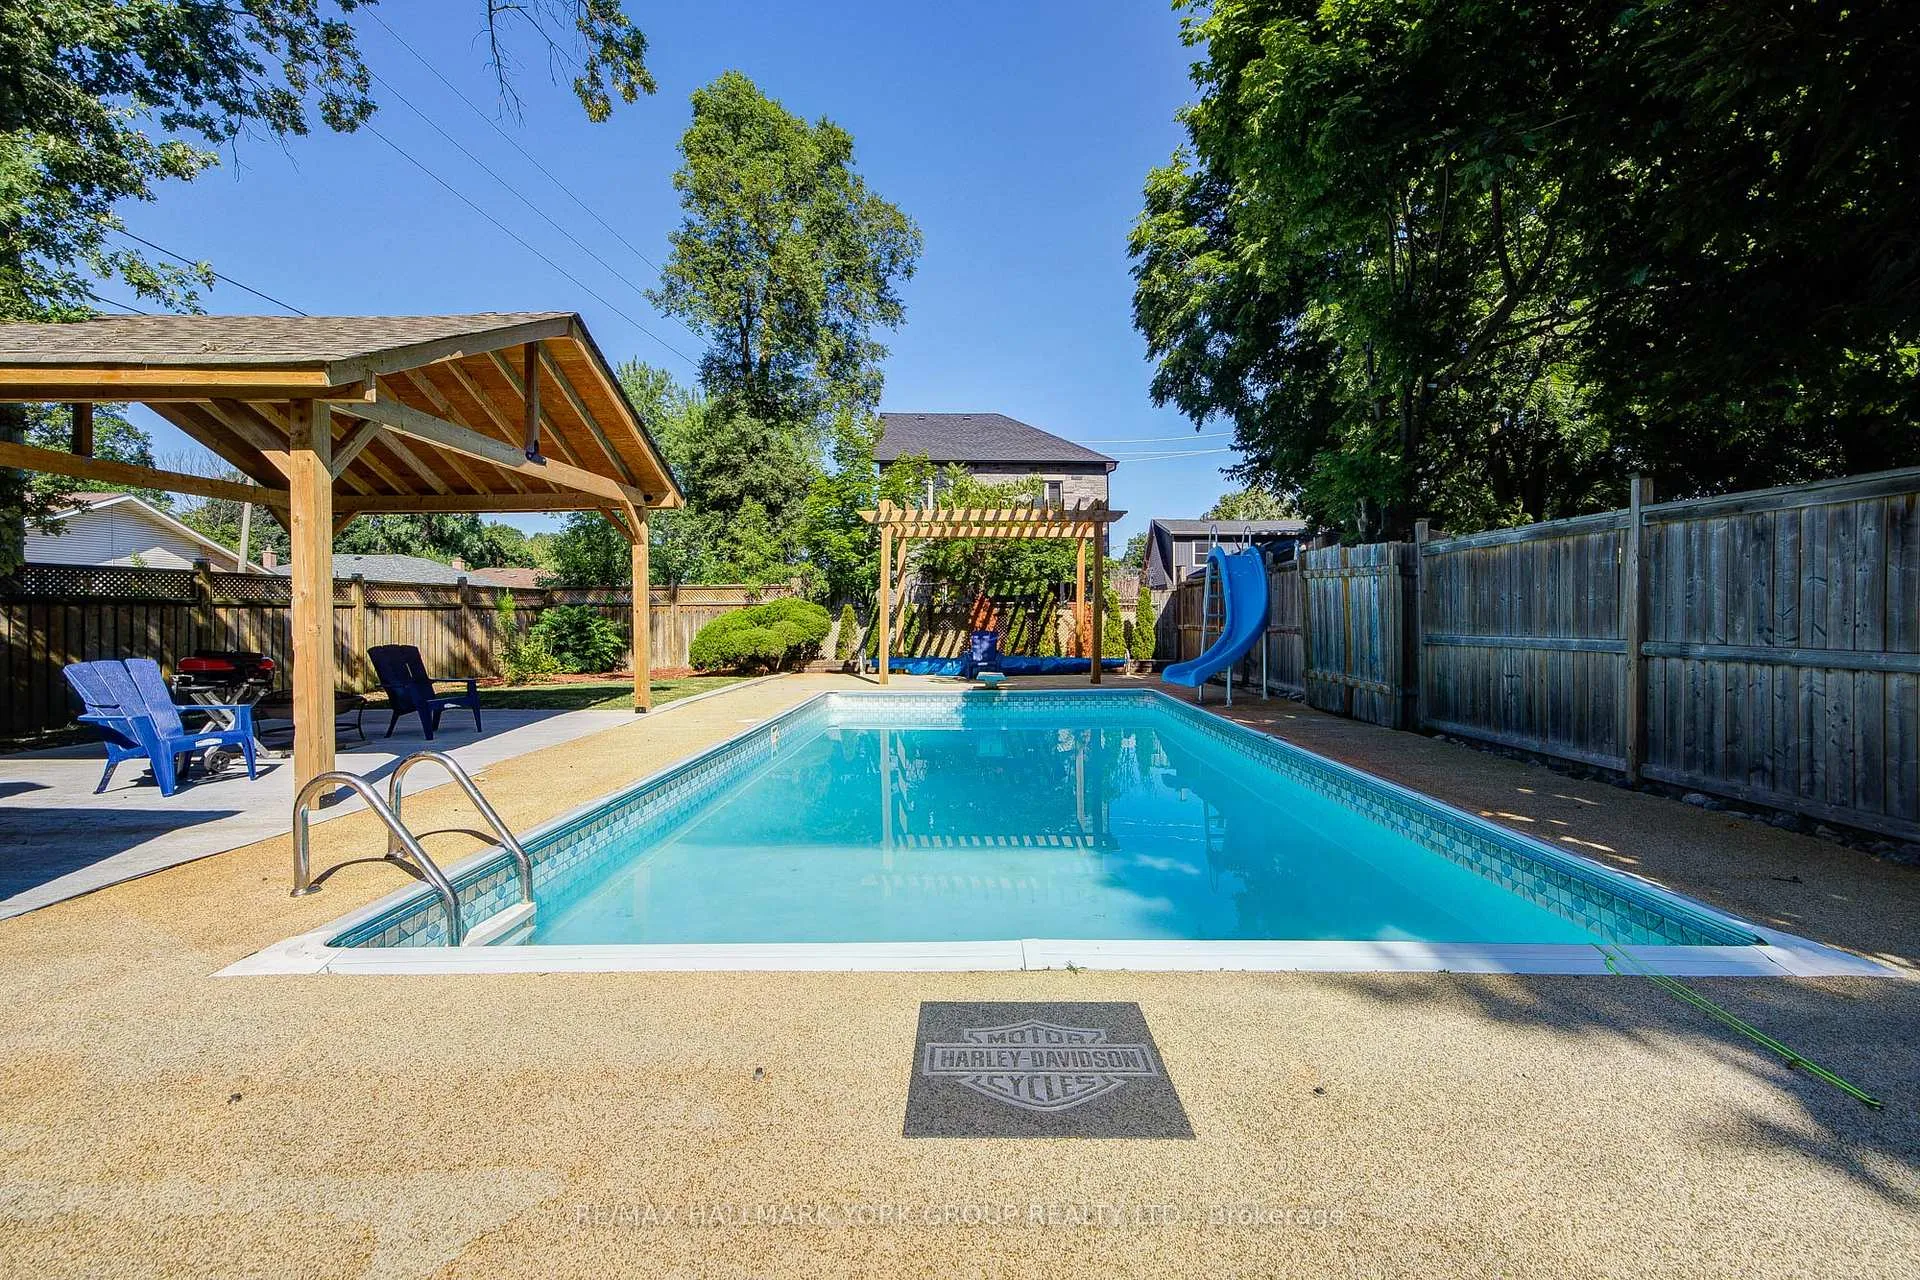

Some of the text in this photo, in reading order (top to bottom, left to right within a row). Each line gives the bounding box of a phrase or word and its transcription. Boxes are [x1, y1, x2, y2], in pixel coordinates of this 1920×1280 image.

[986, 1025, 1087, 1044] MOTOR
[939, 1049, 1142, 1069] HARLEY-DAVIDSON
[985, 1074, 1098, 1101] CYCLES
